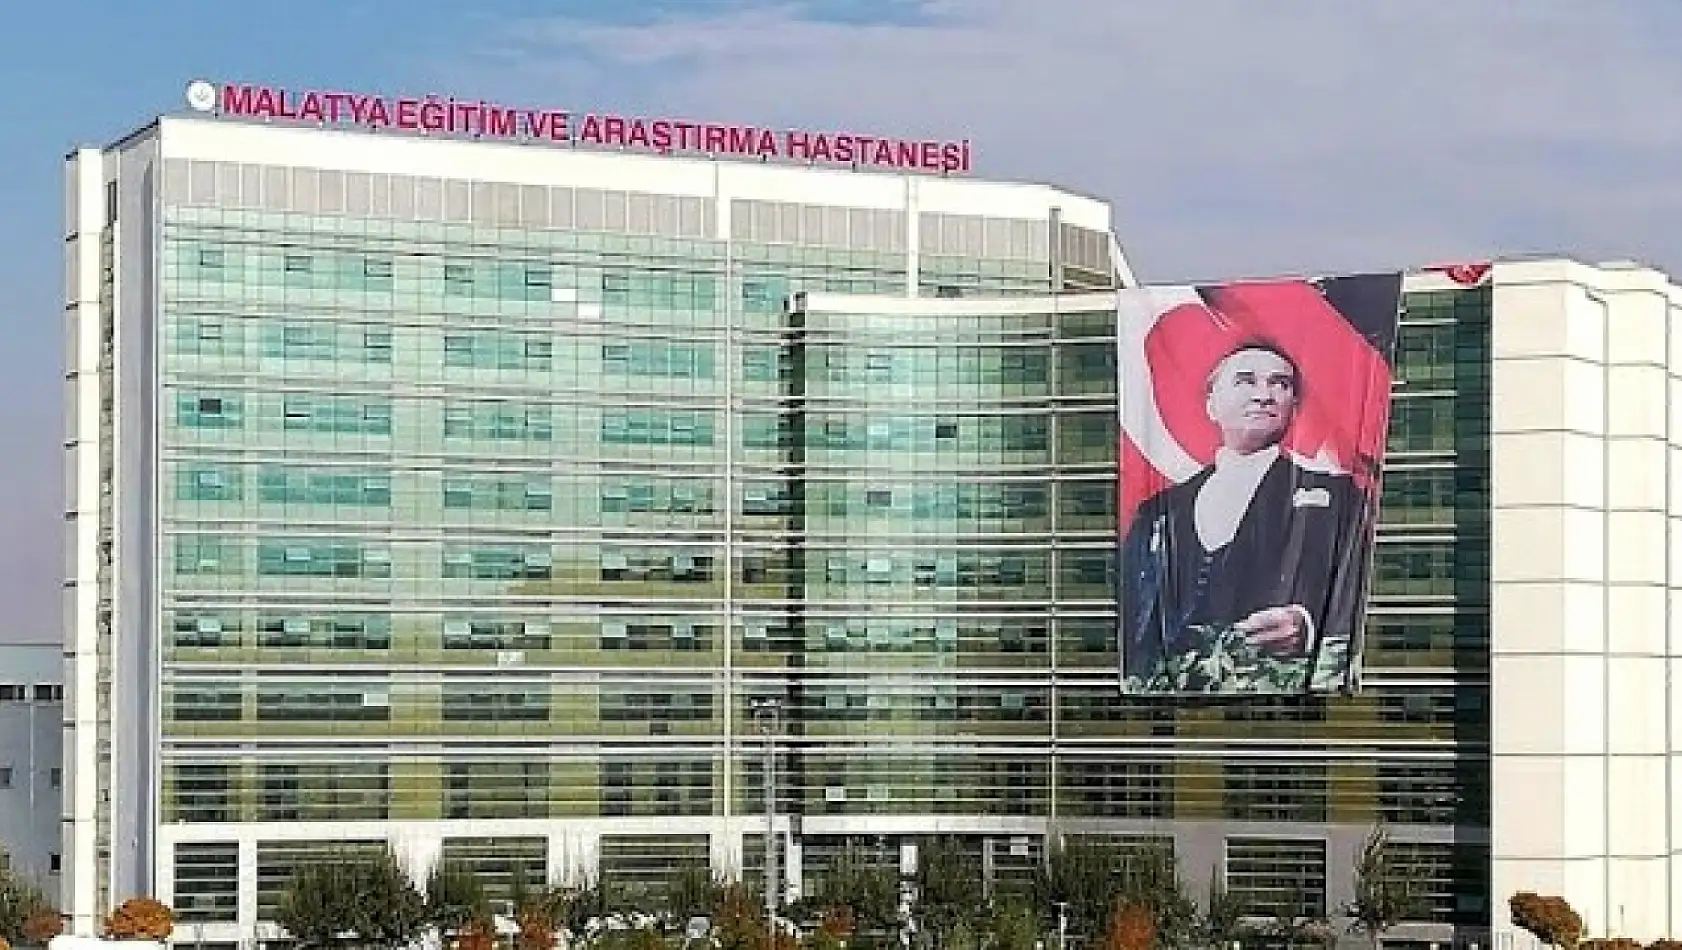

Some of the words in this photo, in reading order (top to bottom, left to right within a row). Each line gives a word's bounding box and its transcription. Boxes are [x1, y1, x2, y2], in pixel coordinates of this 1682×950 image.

[222, 85, 391, 126] MALATYA
[397, 94, 517, 137] EĞİTİM
[527, 110, 570, 141] VE
[580, 114, 778, 156] ARAŞTIRMA
[786, 132, 971, 173] HASTANESİ
